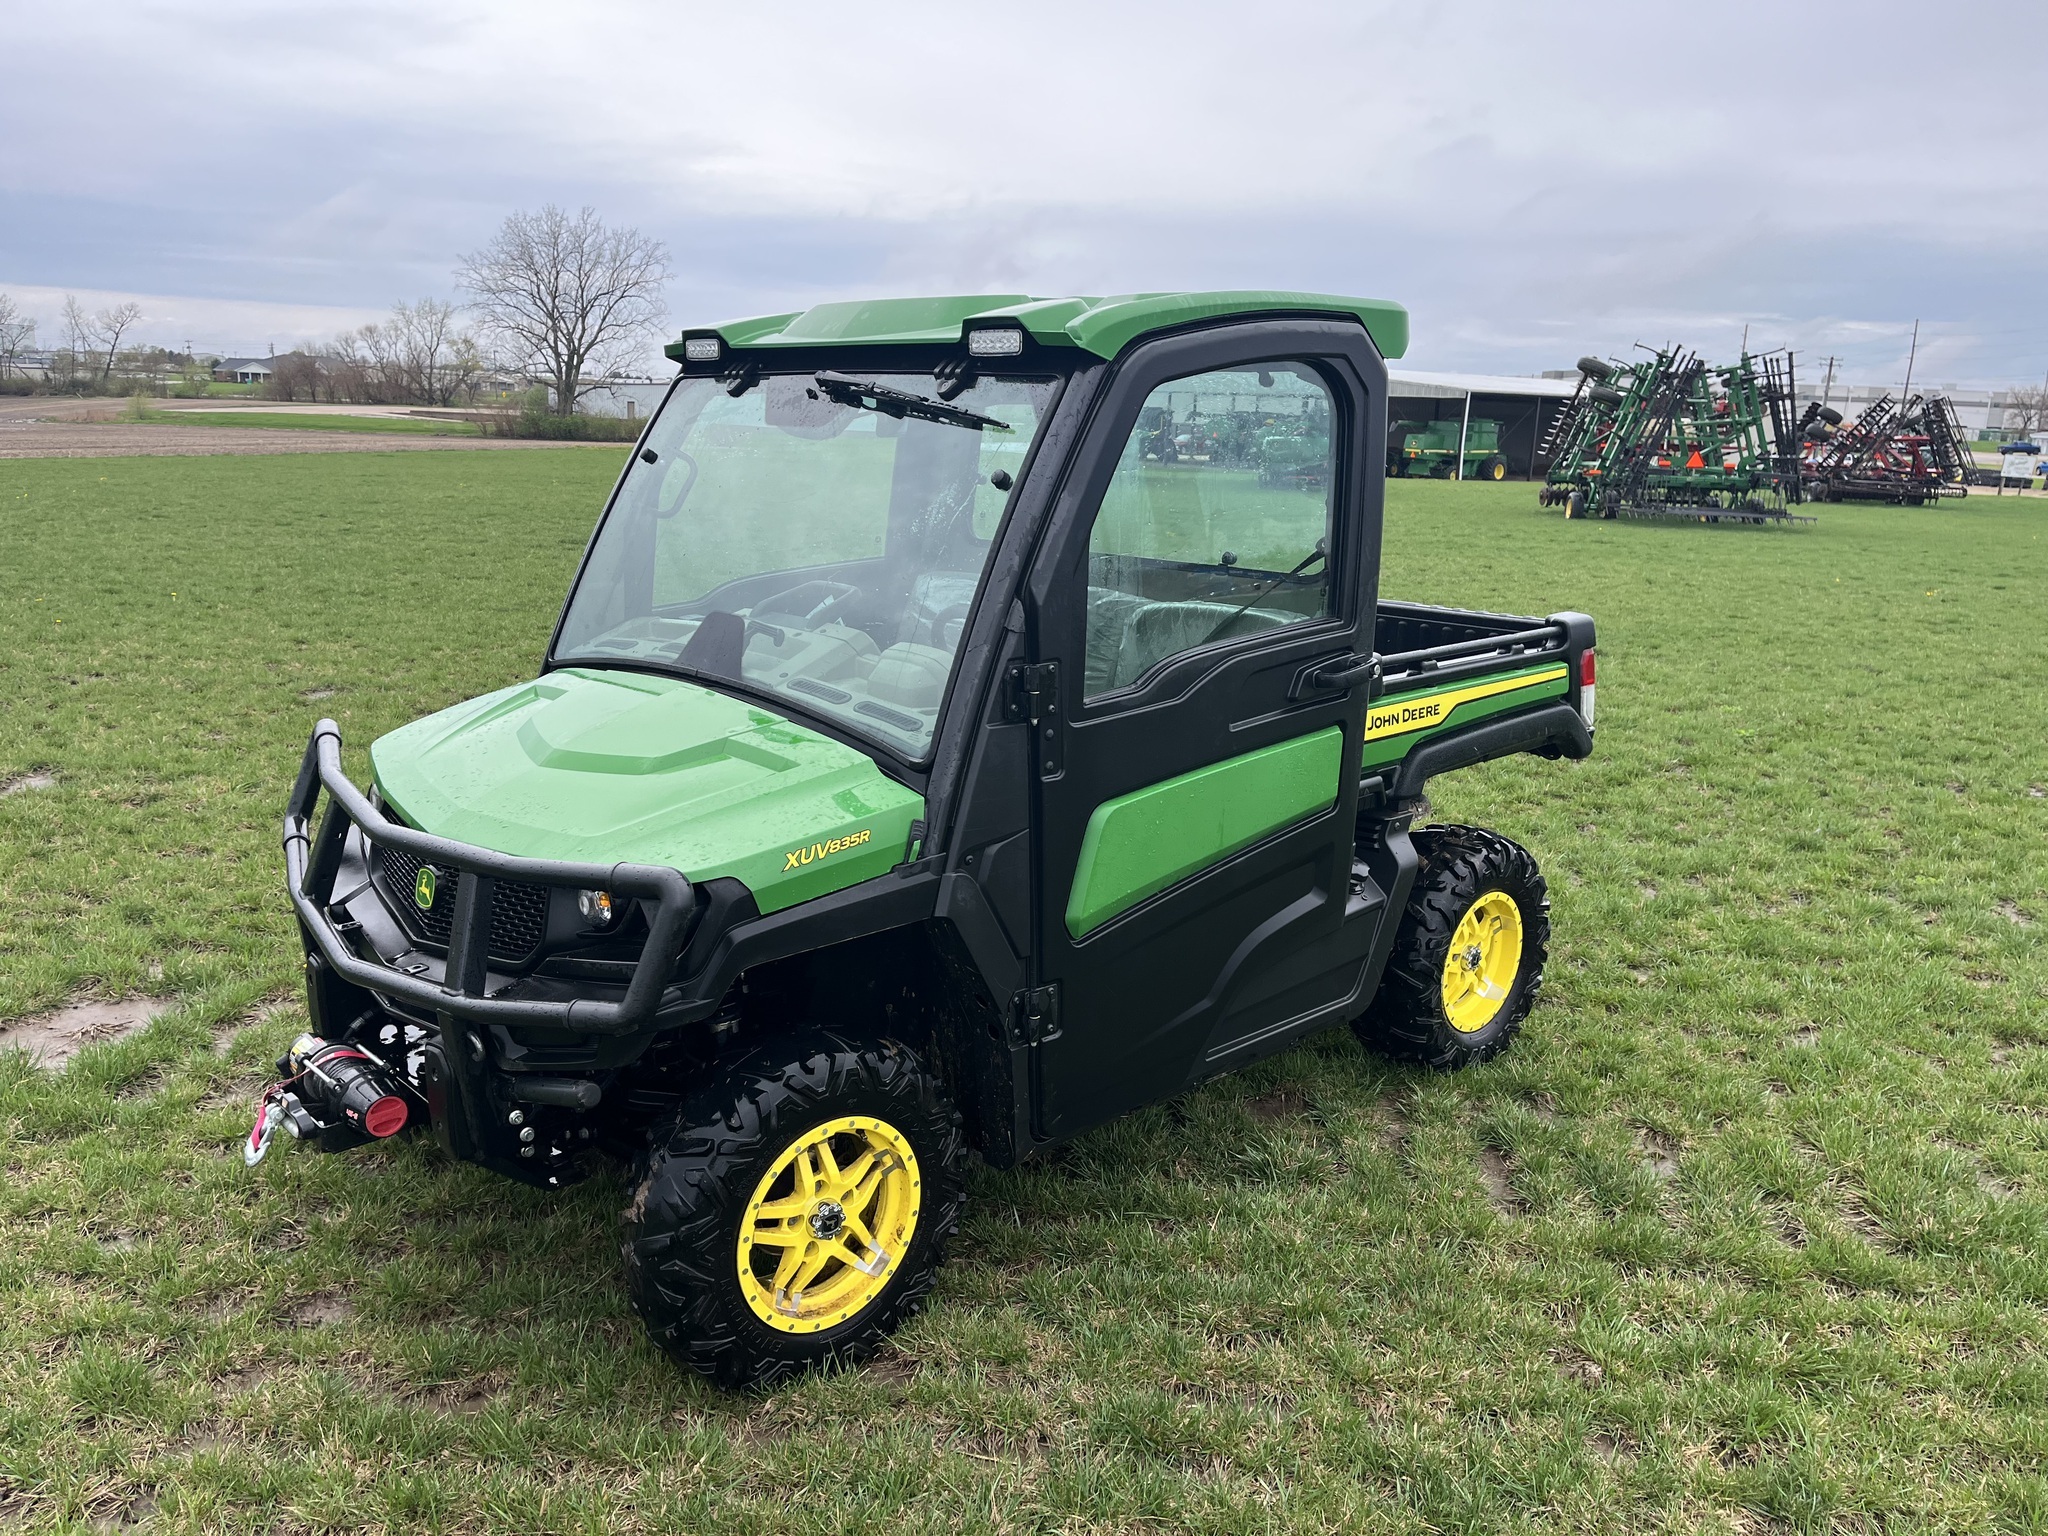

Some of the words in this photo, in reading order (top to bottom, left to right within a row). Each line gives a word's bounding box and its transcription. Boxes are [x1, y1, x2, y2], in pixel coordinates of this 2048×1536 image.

[1367, 712, 1400, 731] JOHN
[1402, 704, 1440, 723] DEERE
[781, 829, 871, 873] XUV835R
